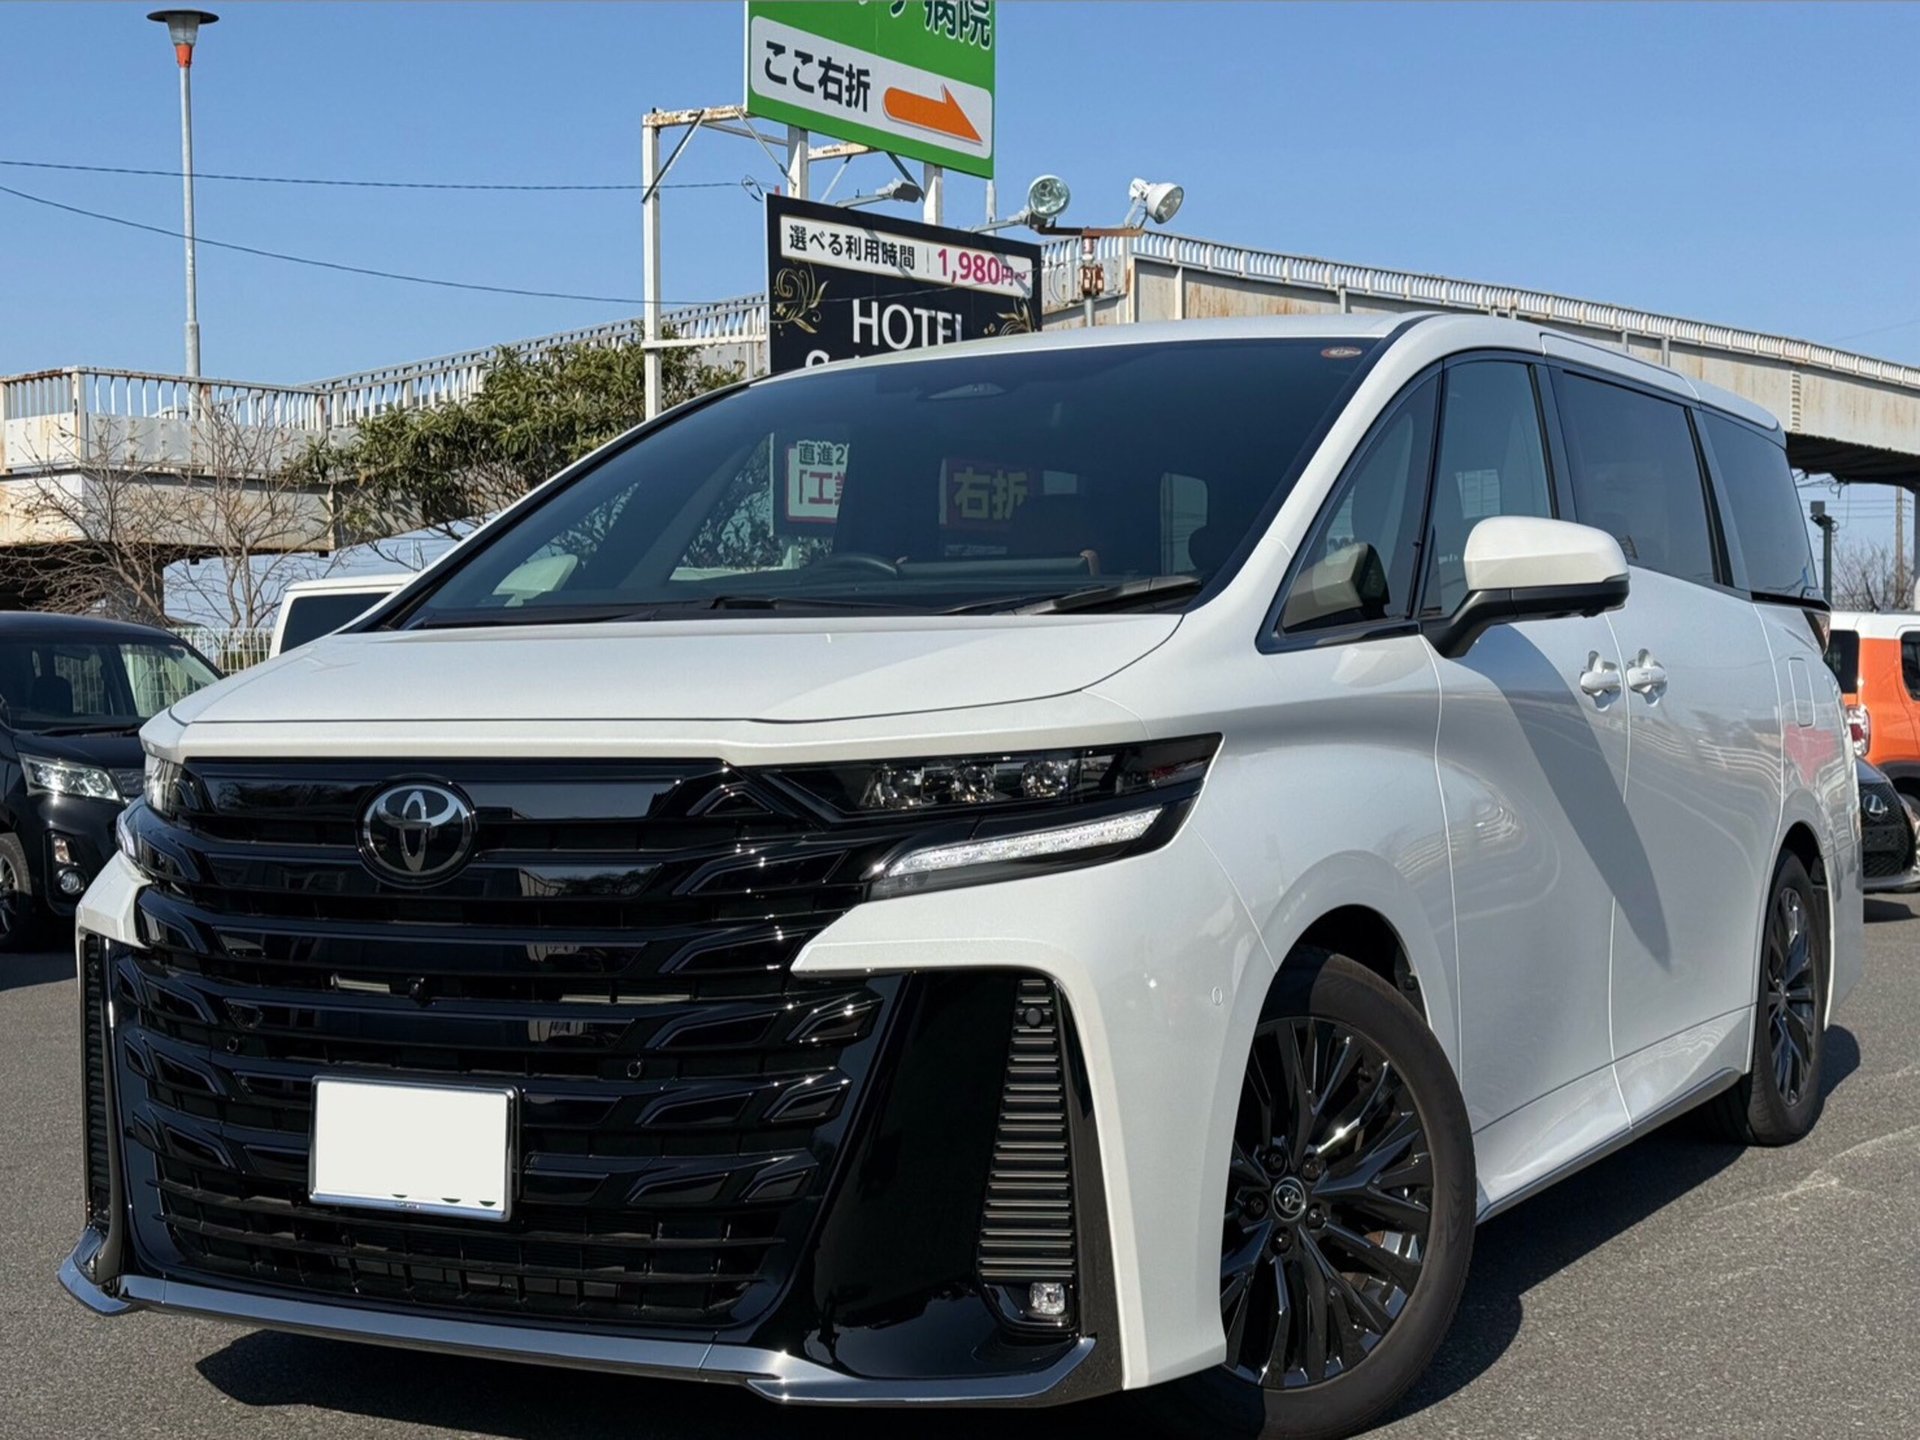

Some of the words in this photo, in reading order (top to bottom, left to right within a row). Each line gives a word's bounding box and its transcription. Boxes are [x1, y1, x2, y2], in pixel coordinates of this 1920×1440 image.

[765, 41, 871, 112] ここ右折
[789, 225, 915, 270] 選べる利用時間
[953, 467, 1028, 520] 右折
